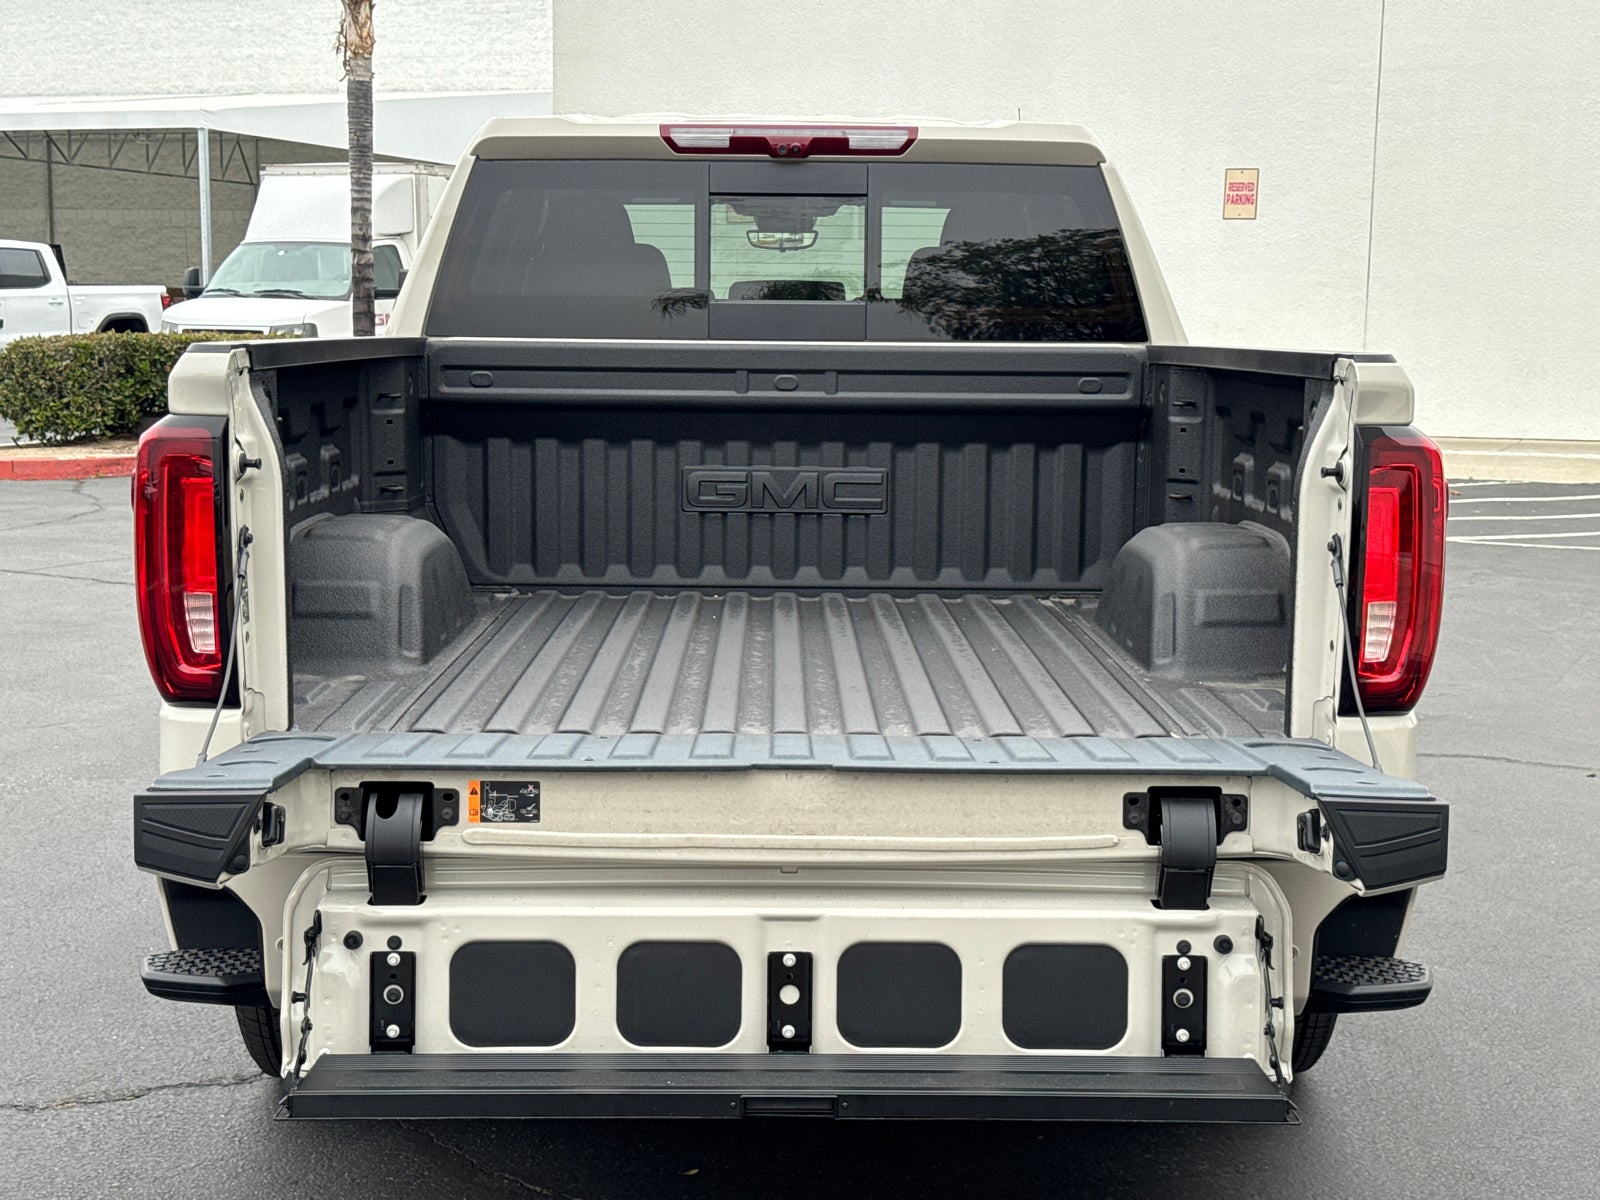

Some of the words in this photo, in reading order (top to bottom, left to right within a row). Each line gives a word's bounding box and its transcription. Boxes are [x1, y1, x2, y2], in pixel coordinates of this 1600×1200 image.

[1228, 182, 1256, 192] RESERVED
[1226, 193, 1255, 205] PARKING
[686, 471, 884, 510] GMC
